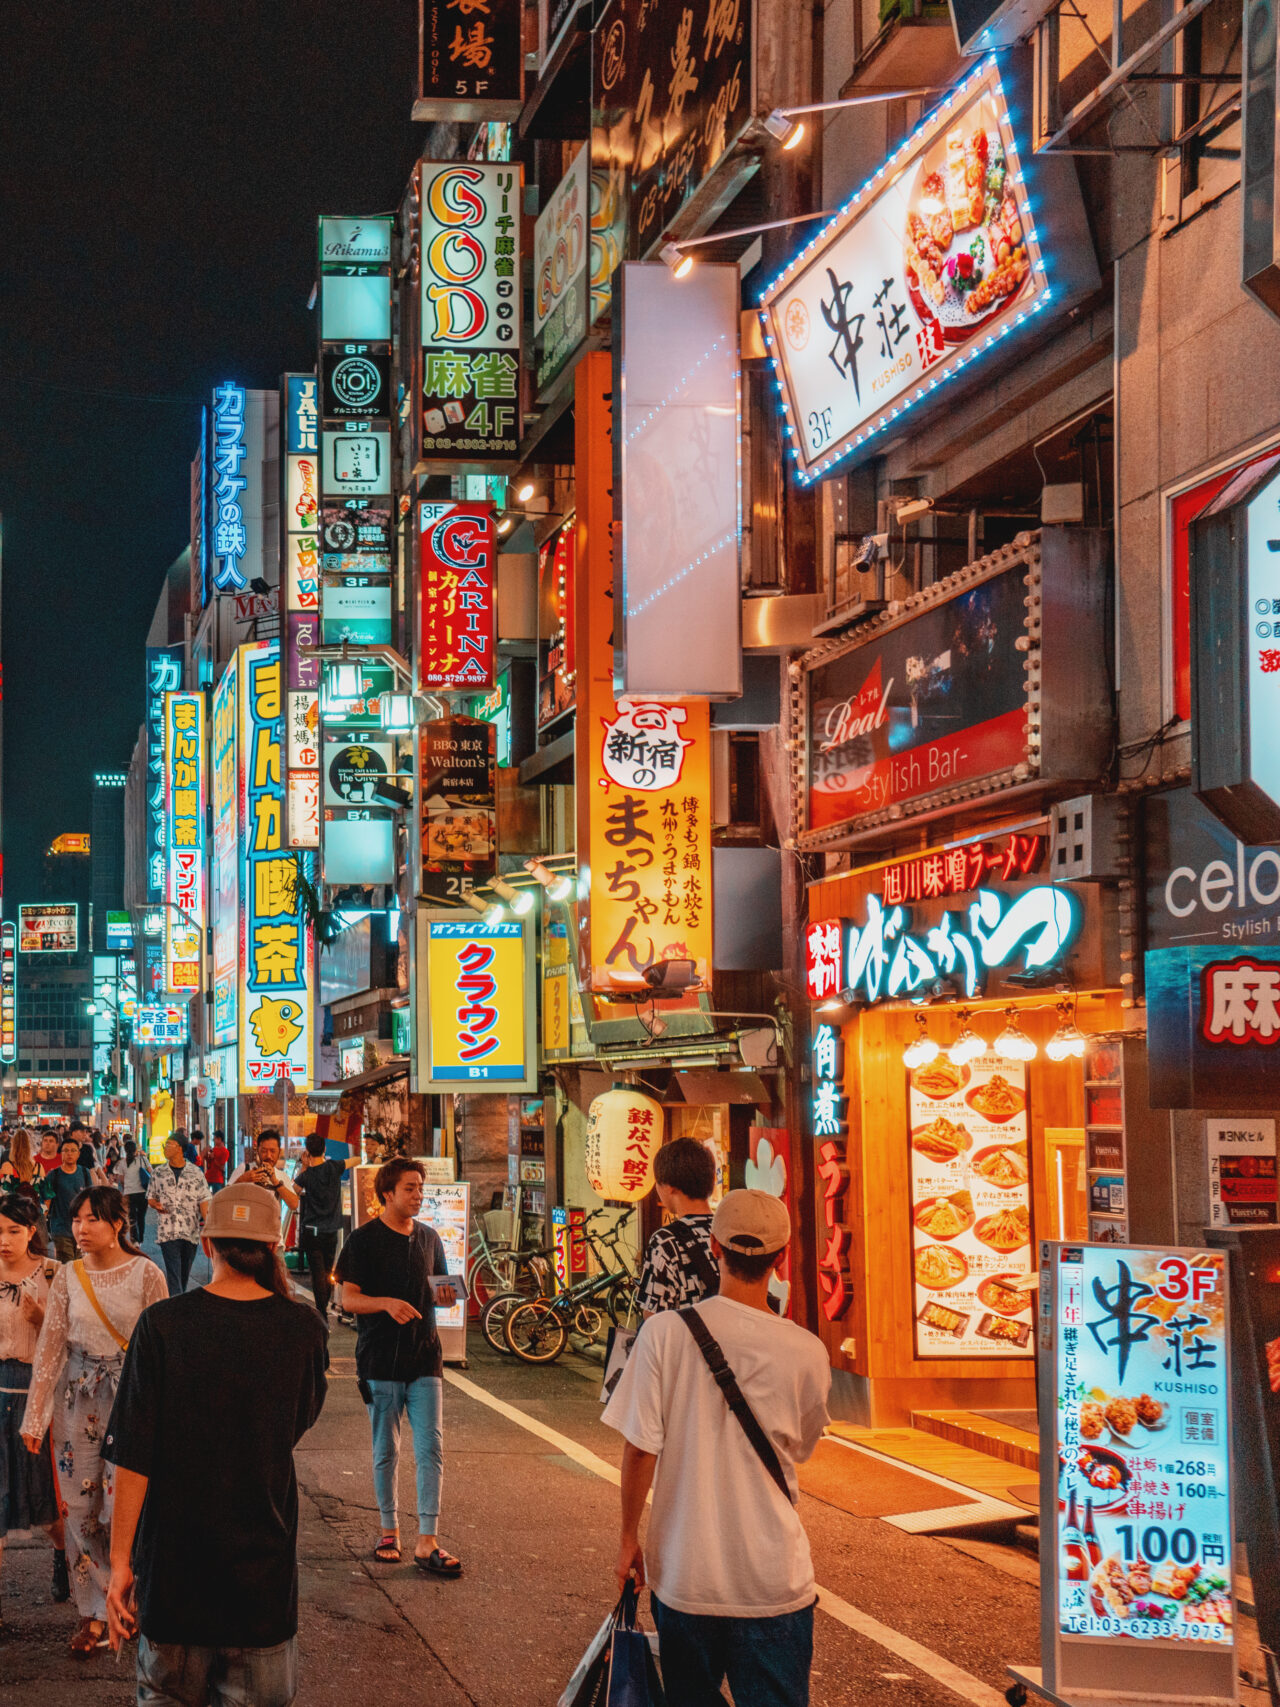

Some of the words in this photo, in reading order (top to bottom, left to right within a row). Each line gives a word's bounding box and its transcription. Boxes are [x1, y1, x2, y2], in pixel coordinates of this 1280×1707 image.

[456, 81, 489, 95] 5F
[494, 173, 515, 277] リーチ麻雀
[427, 166, 489, 343] GOD
[346, 266, 368, 276] 7F
[496, 280, 514, 341] ゴッド
[345, 344, 368, 353] 6F
[424, 351, 518, 399] 麻雀
[872, 352, 913, 394] KUSHISO
[296, 381, 318, 450] JAビル
[345, 421, 368, 431] 5F
[465, 402, 515, 437] 4F
[215, 381, 247, 589] カラオケの鉄人
[345, 500, 369, 509] 4F
[423, 506, 444, 519] 3F
[345, 578, 369, 586] 3F
[431, 515, 488, 675] CARINA
[439, 570, 460, 673] カリーナ
[820, 677, 894, 753] Real
[347, 733, 370, 742] 1F
[433, 740, 457, 751] BBQ
[459, 739, 483, 751] 東京
[430, 754, 486, 768] Walton's
[347, 811, 370, 821] B1
[681, 796, 701, 871] 博多もつ鍋
[660, 799, 680, 925] 九州のうまかもん
[882, 834, 1040, 907] 旭川味噌ラーメン
[604, 795, 659, 976] まっちゃん
[683, 874, 703, 928] 水炊き
[1222, 919, 1269, 939] Stylish
[174, 962, 199, 975] 24h
[174, 976, 199, 987] OPEN
[457, 942, 499, 1063] クラウン
[141, 1012, 167, 1024] 完全
[153, 1024, 178, 1036] 個室
[248, 1061, 306, 1080] マンボー
[469, 1067, 488, 1078] B1
[813, 1023, 841, 1137] 角煮
[620, 1107, 655, 1192] 鉄なべ餃子
[1157, 1259, 1215, 1301] 3F
[1086, 1259, 1218, 1386] 串荘
[1154, 1381, 1218, 1395] KUSHISO
[1185, 1411, 1215, 1425] 個室
[1185, 1426, 1215, 1441] 完備
[1127, 1500, 1187, 1521] 串揚げ
